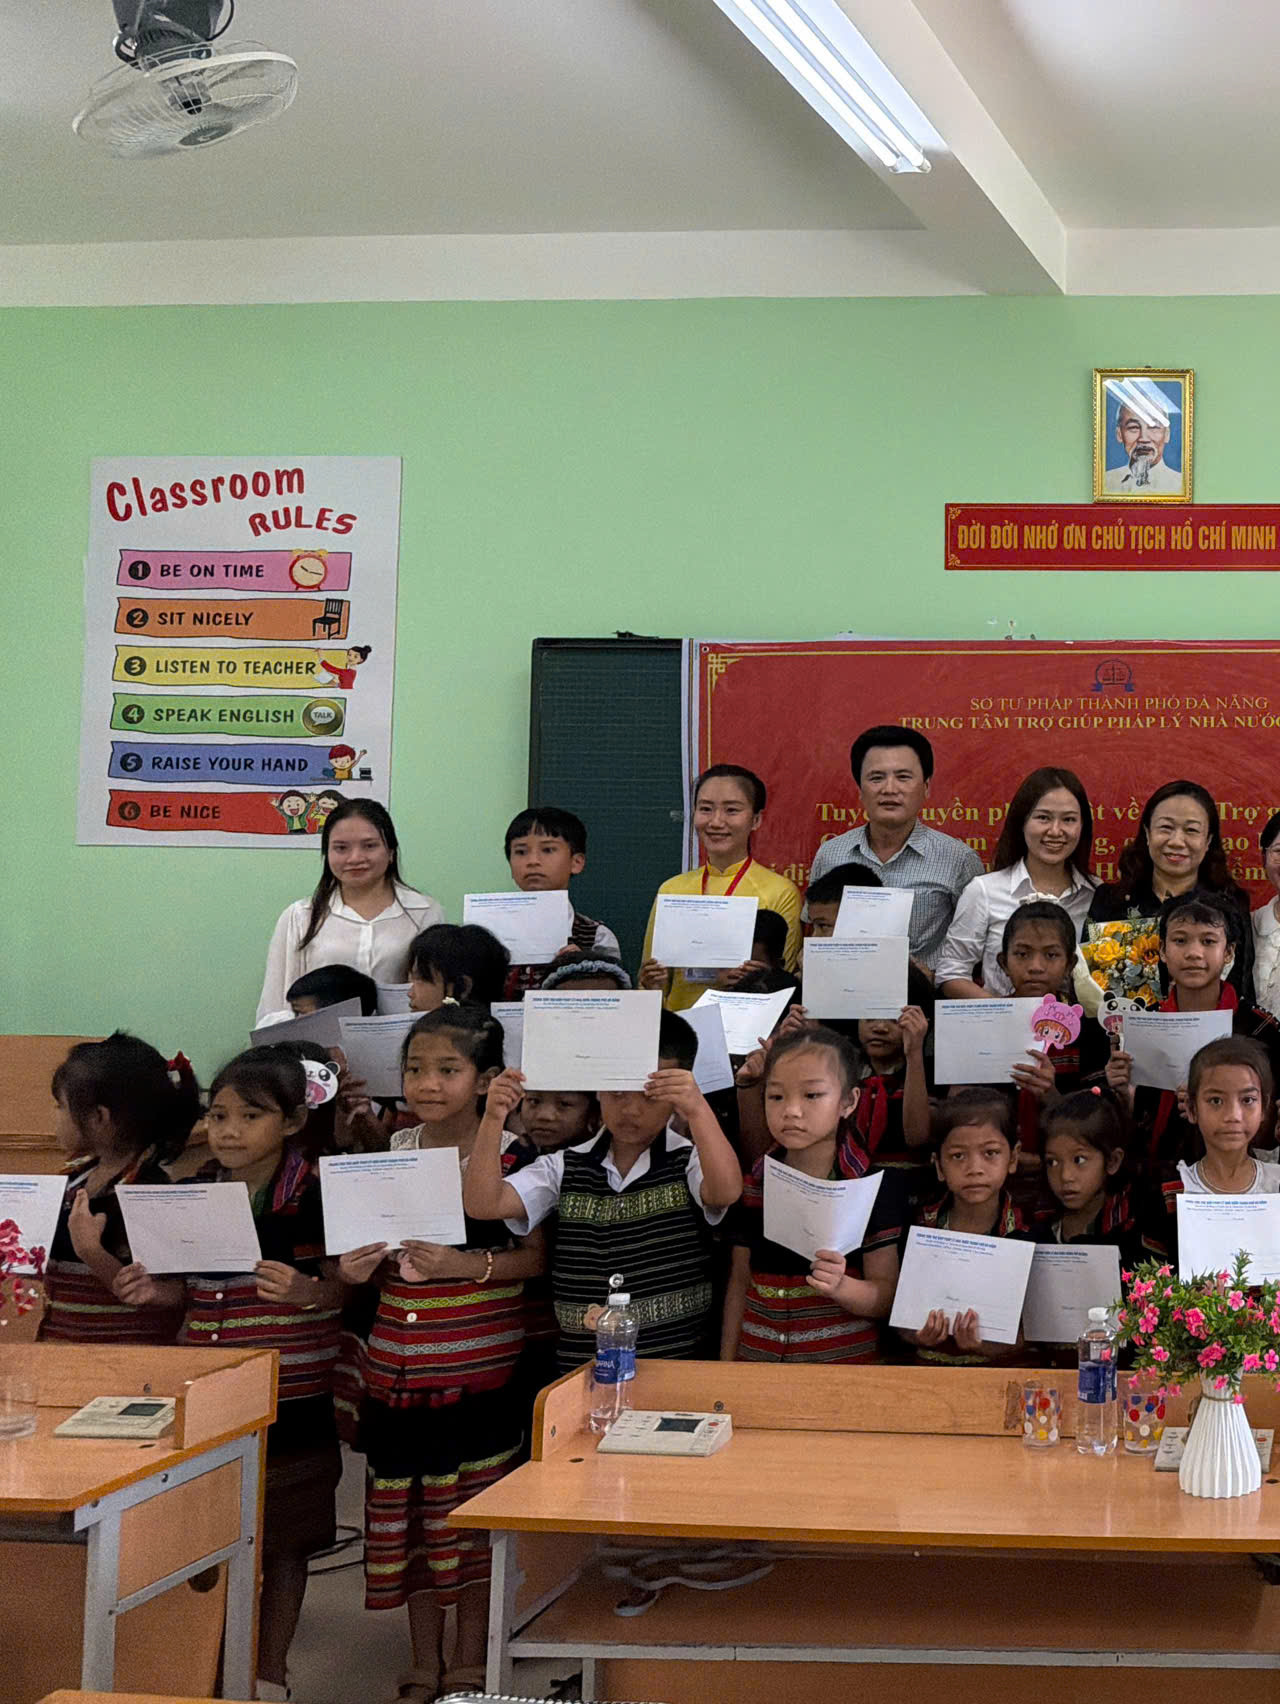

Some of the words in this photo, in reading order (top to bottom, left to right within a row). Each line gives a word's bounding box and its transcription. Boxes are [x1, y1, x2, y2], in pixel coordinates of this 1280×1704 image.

[107, 468, 305, 521] Classroom
[248, 506, 357, 536] RULES
[958, 520, 985, 549] ĐỜI
[990, 520, 1018, 549] ĐỜI
[1023, 521, 1058, 549] NHỚ
[1063, 525, 1086, 549] ƠN
[1092, 518, 1125, 550] CHỦ
[1129, 526, 1165, 554] TỊCH
[1171, 516, 1193, 550] HỒ
[1198, 521, 1226, 550] CHÍ
[1231, 526, 1276, 550] MINH
[159, 564, 181, 577] BE
[190, 564, 215, 577] ON
[223, 564, 265, 577] TIME
[157, 613, 184, 626] SIT
[193, 613, 254, 626] NICELY
[155, 660, 213, 674] LISTEN
[217, 660, 238, 674] TO
[243, 661, 316, 675] TEACHER
[1028, 695, 1073, 710] PHÁP
[1077, 695, 1138, 710] THÀNH
[1145, 695, 1180, 710] PHỐ
[1185, 694, 1210, 709] ĐÀ
[153, 708, 211, 722] SPEAK
[218, 709, 294, 723] ENGLISH
[313, 711, 334, 719] TALK
[900, 717, 963, 729] TRUNG
[968, 714, 1009, 728] TÂM
[1015, 717, 1053, 731] TRỢ
[1058, 713, 1103, 728] GIÚP
[1108, 713, 1156, 728] PHÁP
[1159, 713, 1183, 728] LÝ
[1190, 713, 1228, 728] NHÀ
[151, 757, 201, 770] RAISE
[209, 757, 254, 771] YOUR
[261, 758, 308, 771] HAND
[150, 805, 172, 819] BE
[180, 805, 221, 819] NICE
[816, 803, 869, 826] Tuy
[922, 797, 979, 826] uyền
[1113, 796, 1140, 820] về
[1215, 802, 1261, 825] Trợ
